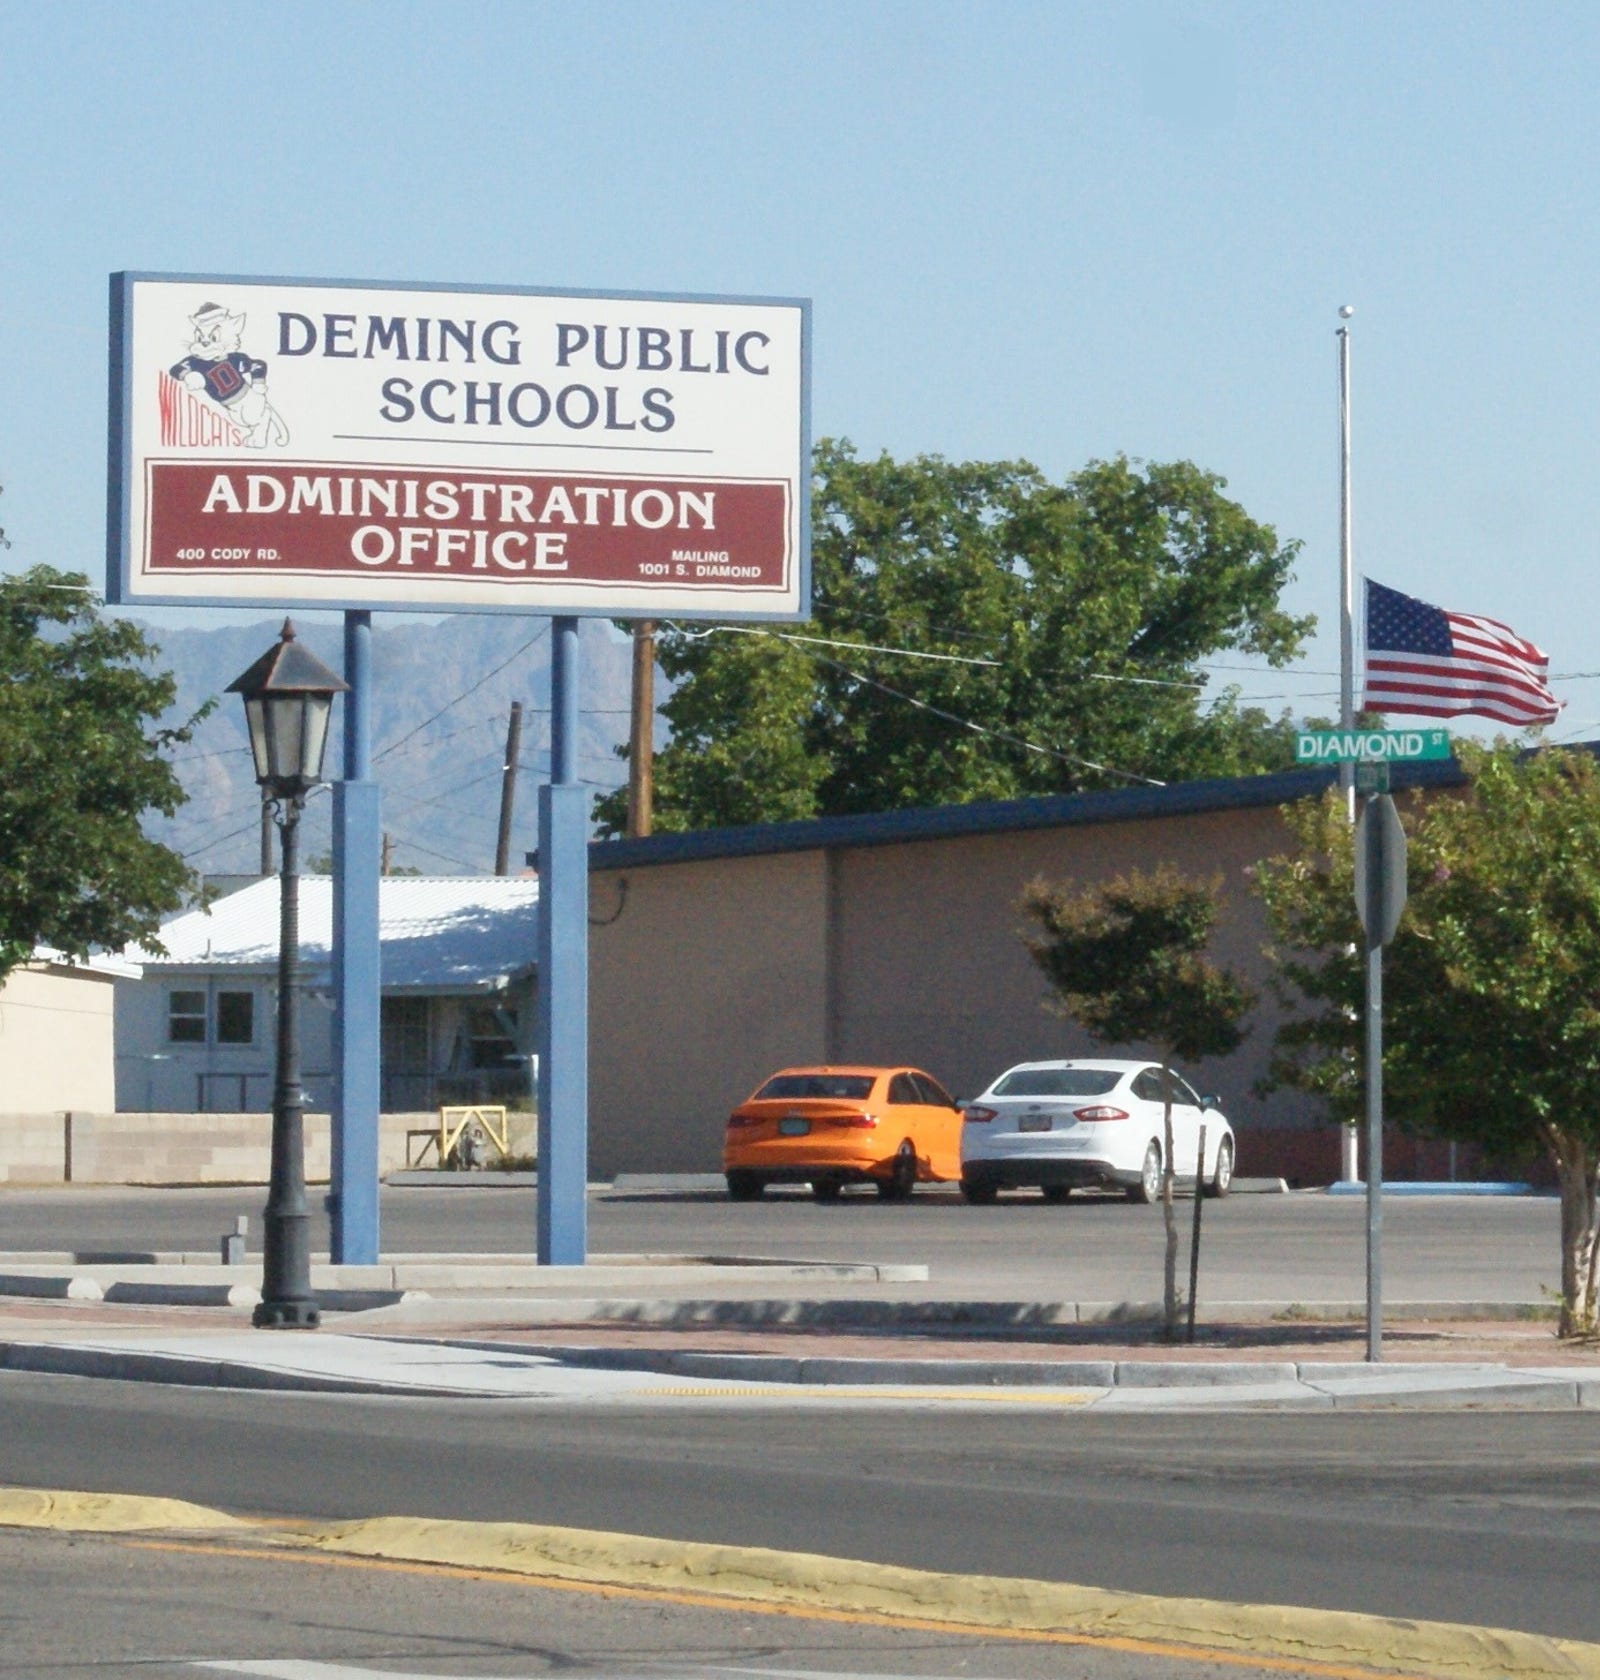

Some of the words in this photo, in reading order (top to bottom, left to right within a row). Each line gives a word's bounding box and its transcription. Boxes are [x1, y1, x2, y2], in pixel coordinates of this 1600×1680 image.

[277, 312, 522, 365] DEMING
[555, 323, 771, 376] PUBLIC
[158, 370, 242, 447] WILDCATS
[379, 377, 676, 433] SCHOOLS
[201, 474, 716, 530] ADMINISTRATION
[176, 548, 205, 560] 400
[211, 548, 251, 560] CODY
[257, 548, 281, 561] RD.
[351, 525, 568, 571] OFFICE
[638, 563, 670, 575] 1001
[675, 564, 690, 576] S.
[696, 564, 761, 578] DIAMOND
[672, 550, 729, 563] MAILING
[1299, 733, 1423, 758] DIAMOND
[1431, 733, 1443, 745] ST
